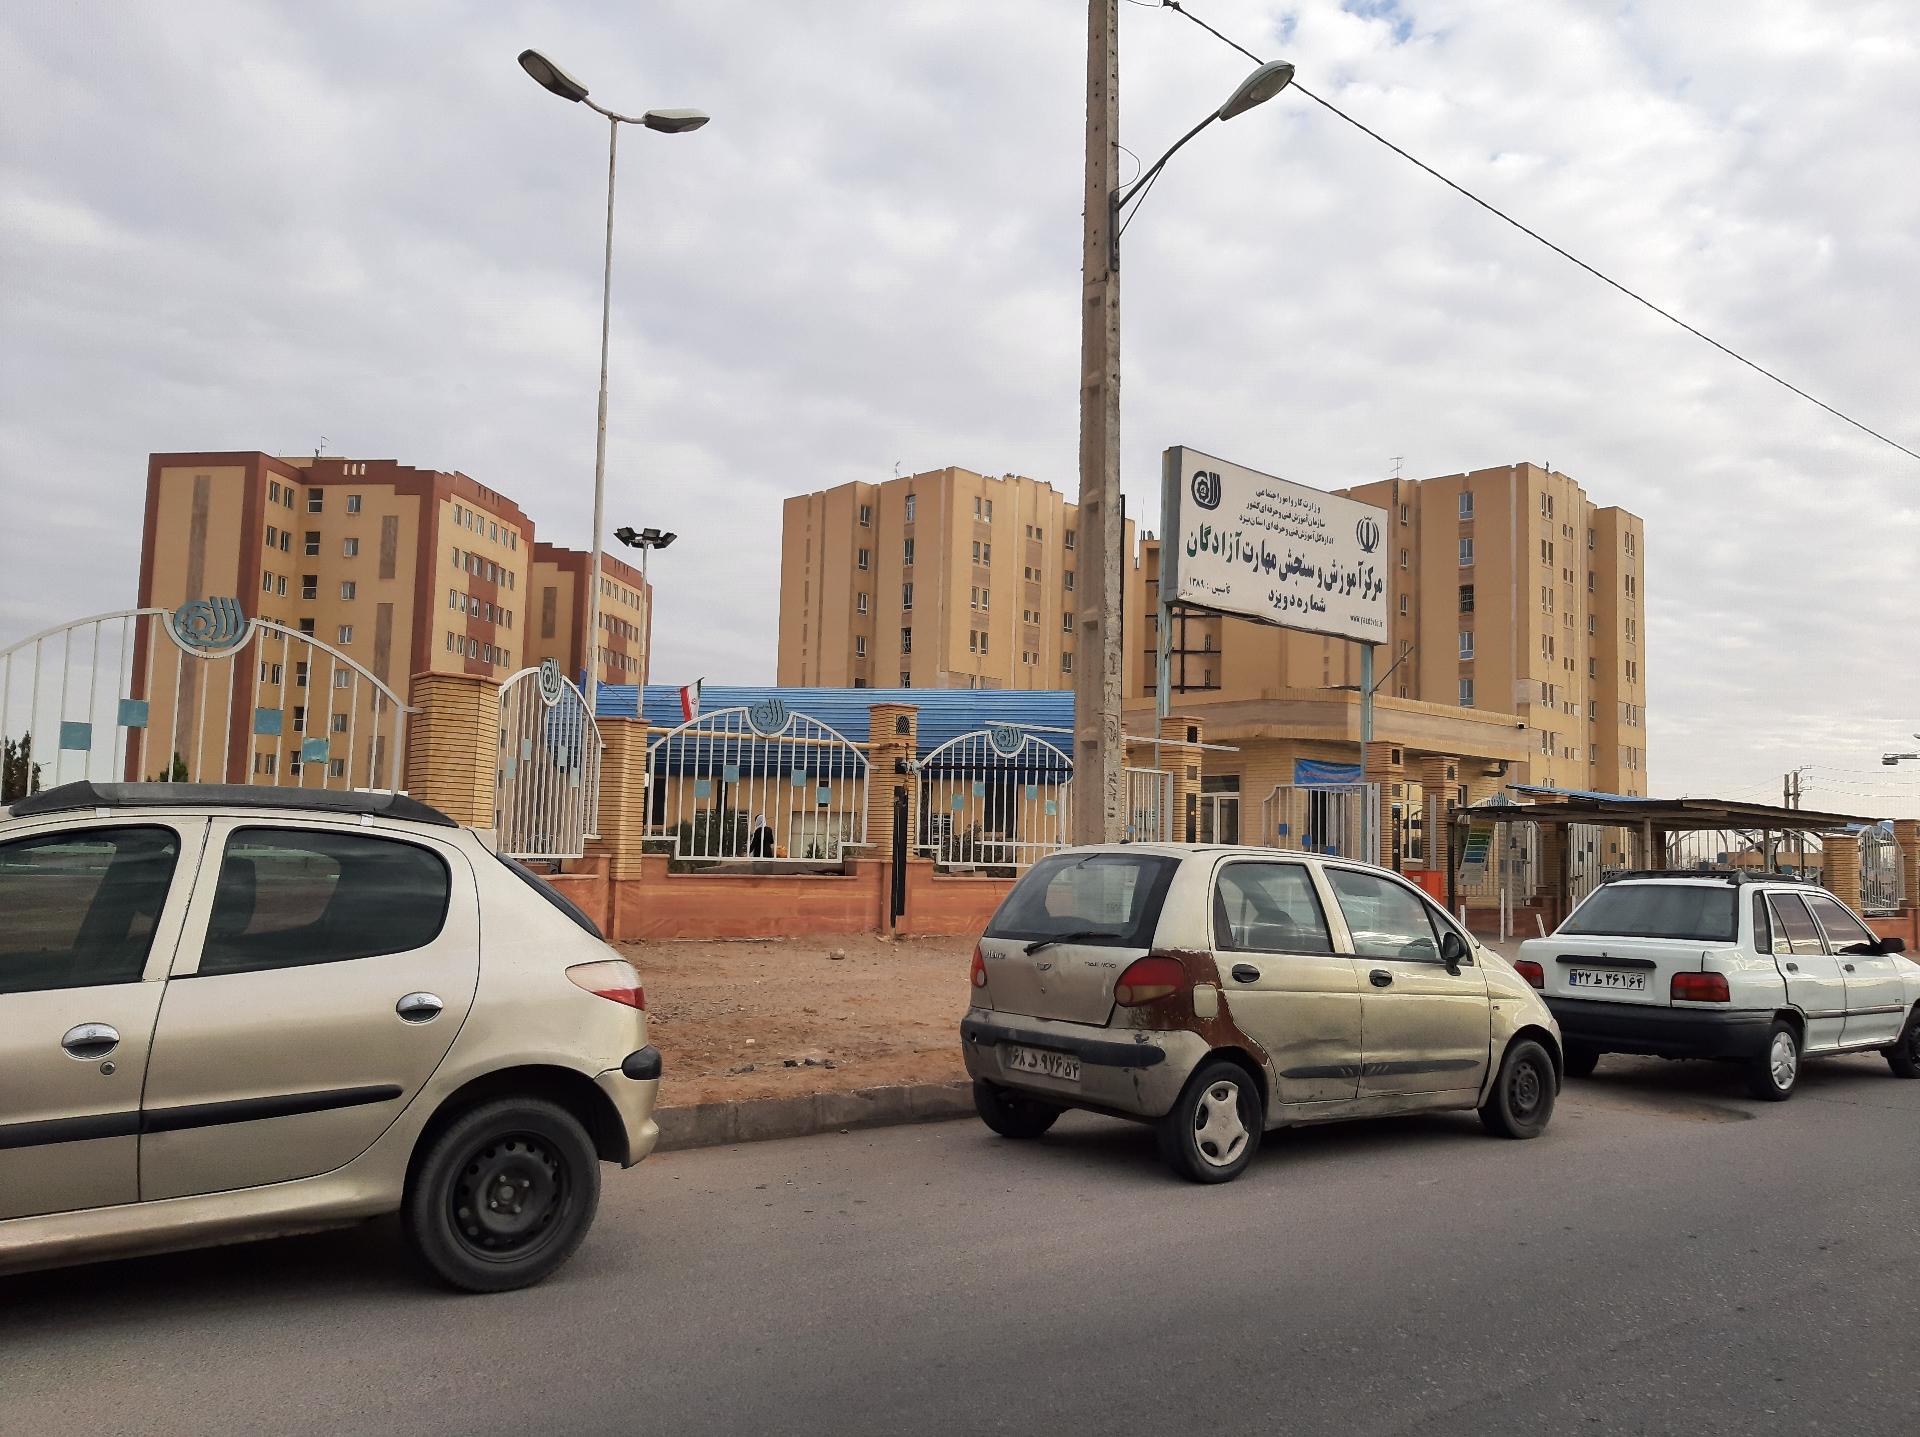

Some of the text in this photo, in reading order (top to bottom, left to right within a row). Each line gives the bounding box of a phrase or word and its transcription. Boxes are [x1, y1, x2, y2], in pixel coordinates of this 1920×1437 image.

[1255, 488, 1280, 501] اجتماعی
[1246, 500, 1260, 510] کشور
[1303, 500, 1321, 514] وزارت
[1238, 513, 1250, 525] یزد
[1282, 510, 1292, 520] فنی
[1291, 513, 1308, 525] آموزش
[1251, 516, 1266, 527] استان
[1307, 516, 1326, 529] سازمان
[1289, 527, 1298, 537] فنی
[1297, 530, 1315, 541] آموزش
[1321, 534, 1334, 545] اداره
[1186, 521, 1384, 602] مرکز آموزش و سنجش مهارت آزادگان
[1189, 576, 1205, 589] ۱۳۸۹
[1268, 589, 1327, 614] شماره دو یزد
